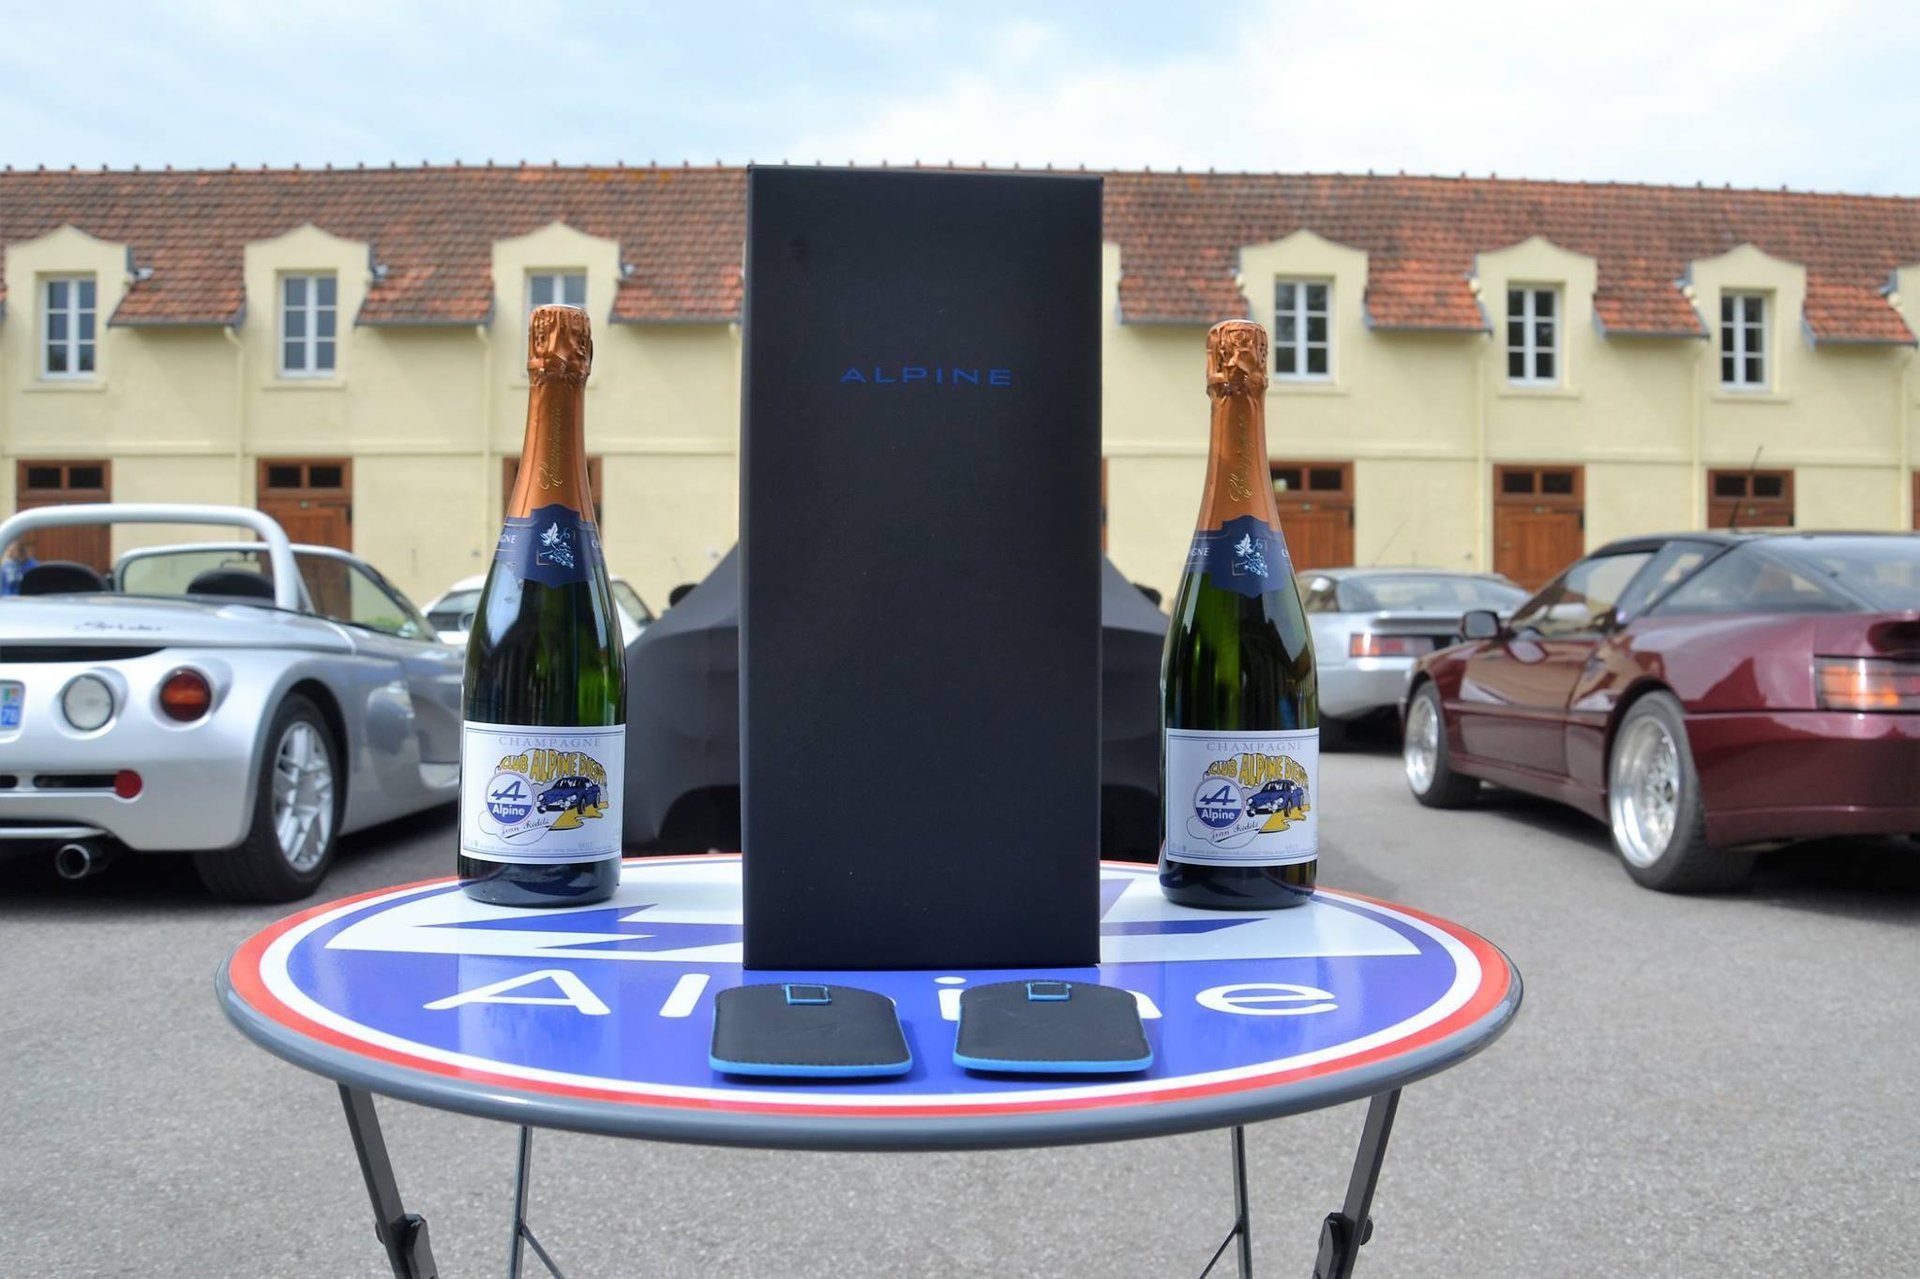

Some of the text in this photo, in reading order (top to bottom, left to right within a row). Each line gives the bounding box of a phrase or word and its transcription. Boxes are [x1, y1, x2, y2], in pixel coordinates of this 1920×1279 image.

[840, 367, 1012, 385] ALPINE
[498, 736, 601, 748] CHAMPAGNE
[500, 754, 529, 774] CLUB
[530, 748, 578, 783] ALPINE
[1208, 759, 1238, 778] CLUB
[1238, 753, 1284, 787] ALPINE
[492, 804, 525, 817] Alpine
[1201, 808, 1236, 822] Alpine
[423, 969, 1338, 1020] Alie
